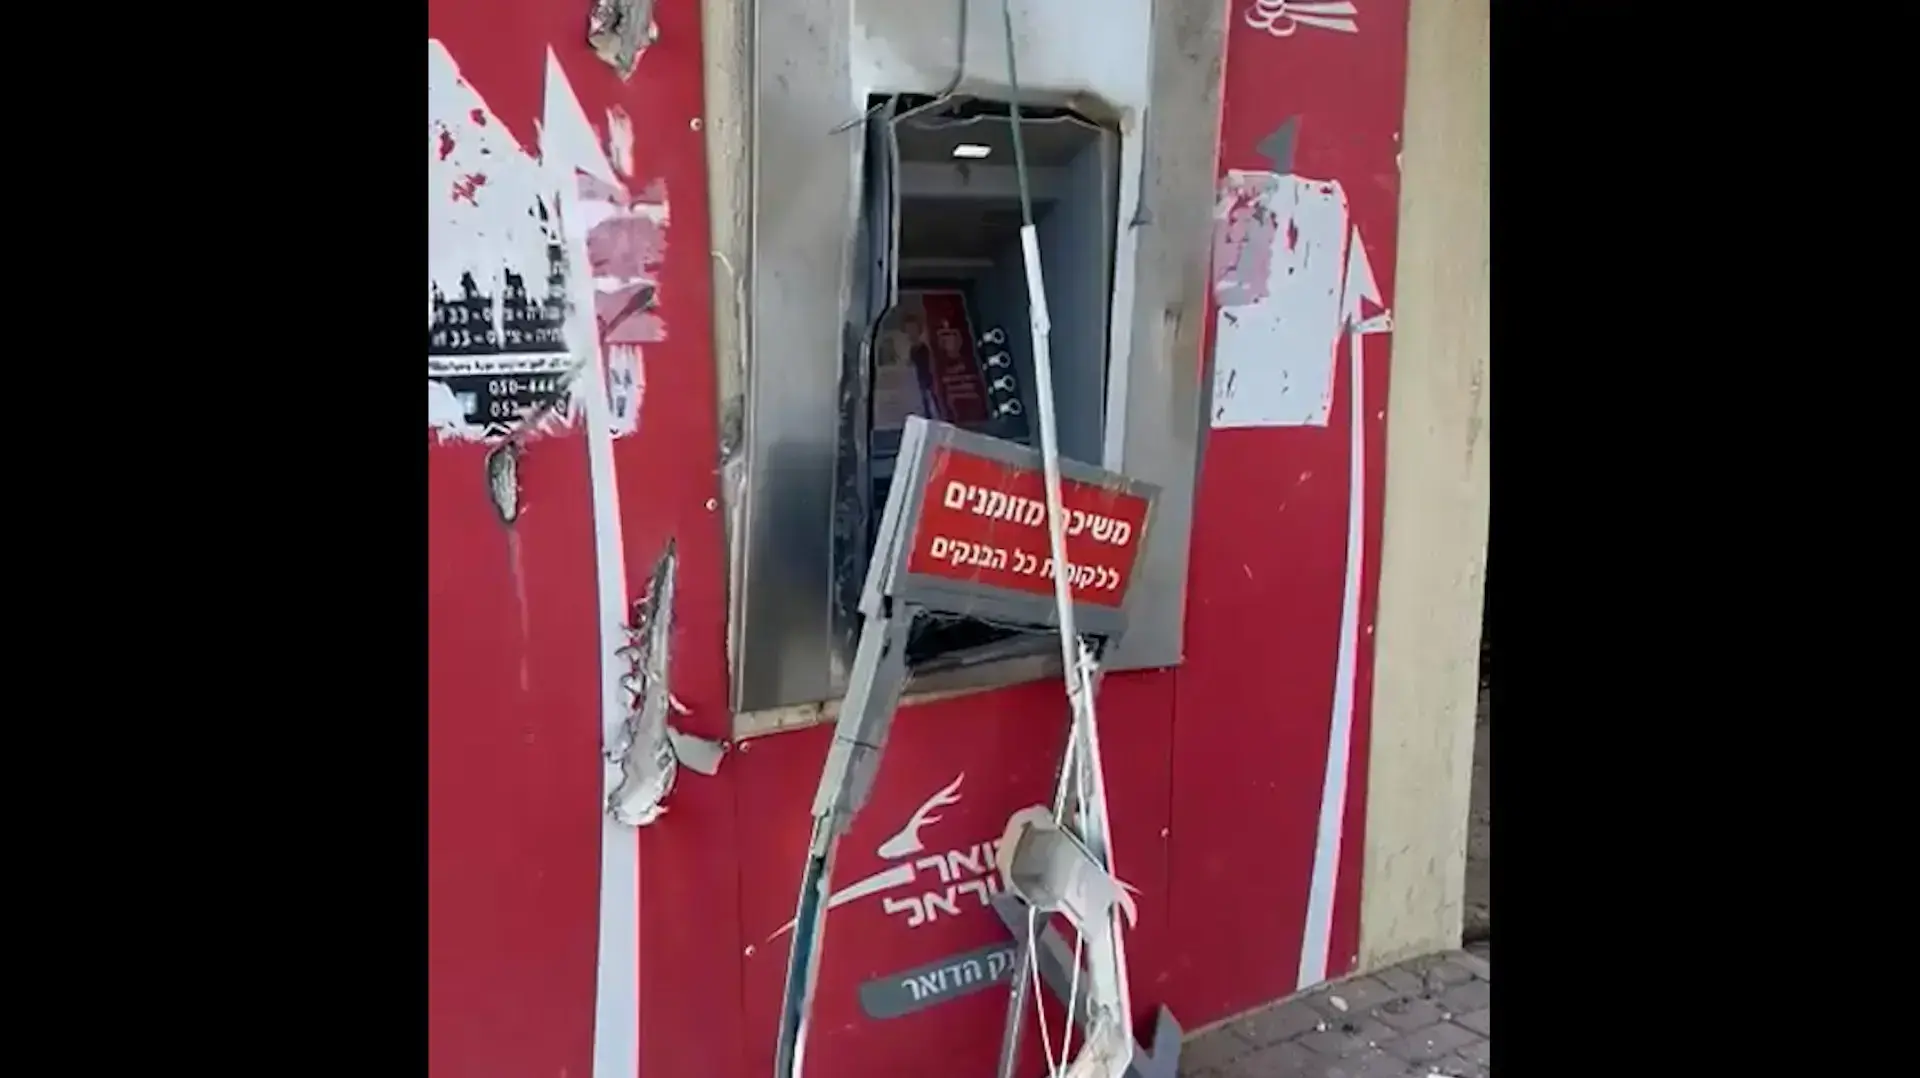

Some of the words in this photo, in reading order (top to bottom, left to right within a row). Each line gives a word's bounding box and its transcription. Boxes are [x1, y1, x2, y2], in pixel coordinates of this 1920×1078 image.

[944, 480, 1046, 527] מזומנים
[930, 535, 1007, 570] הבנקים
[1011, 547, 1037, 576] כל
[916, 839, 1001, 882] ואר
[901, 959, 983, 1001] הדואר
